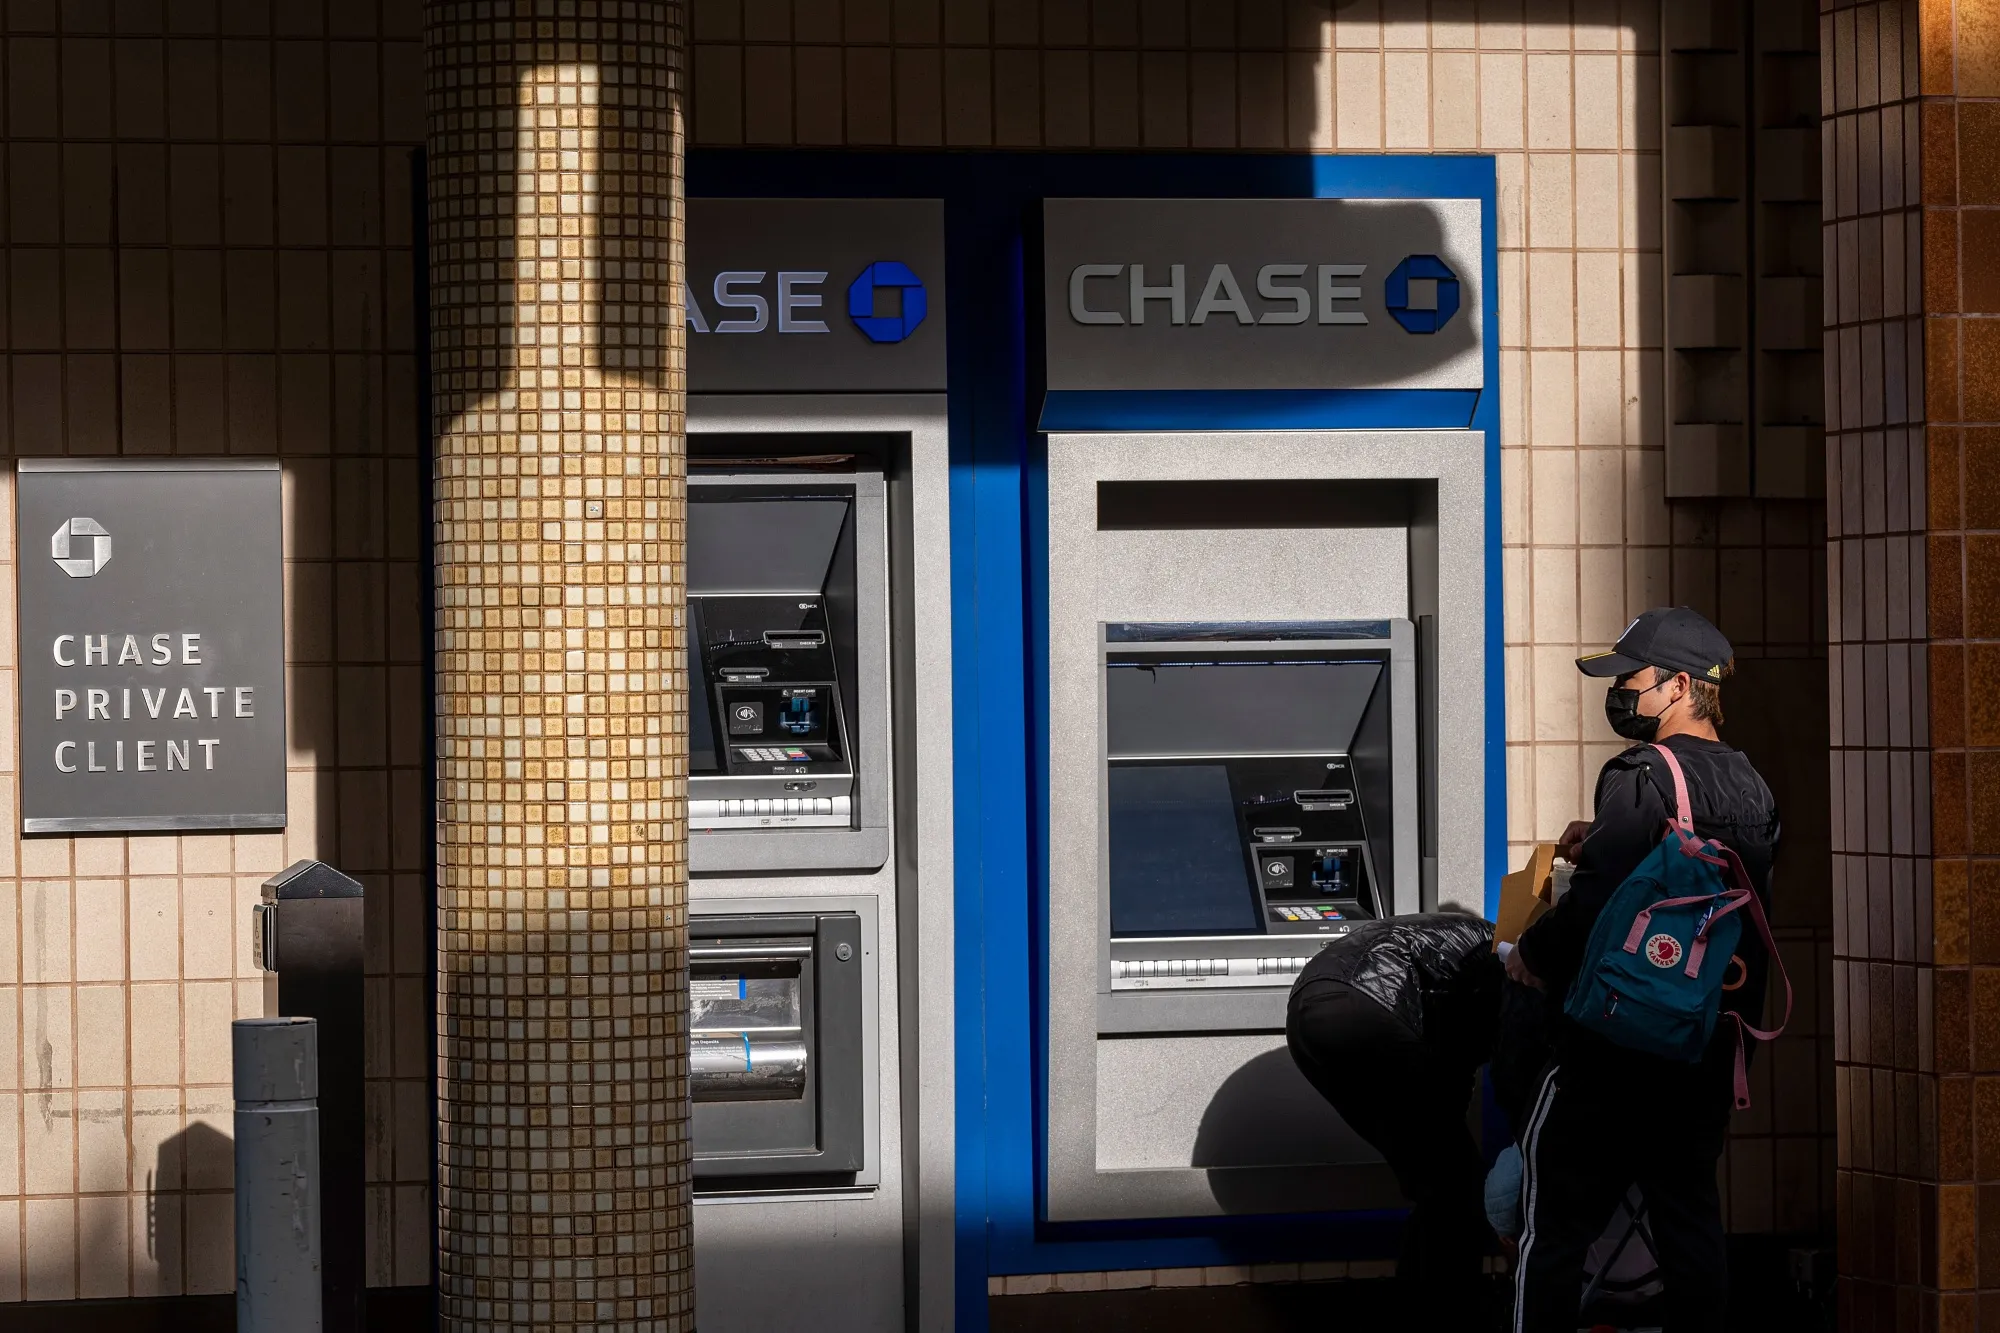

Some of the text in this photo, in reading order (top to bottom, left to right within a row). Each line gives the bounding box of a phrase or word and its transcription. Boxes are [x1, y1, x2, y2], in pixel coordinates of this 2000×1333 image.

[1069, 263, 1370, 326] CHASE
[52, 633, 202, 667] CHASE
[55, 686, 255, 721] PRIVATE
[54, 738, 220, 774] CLIENT
